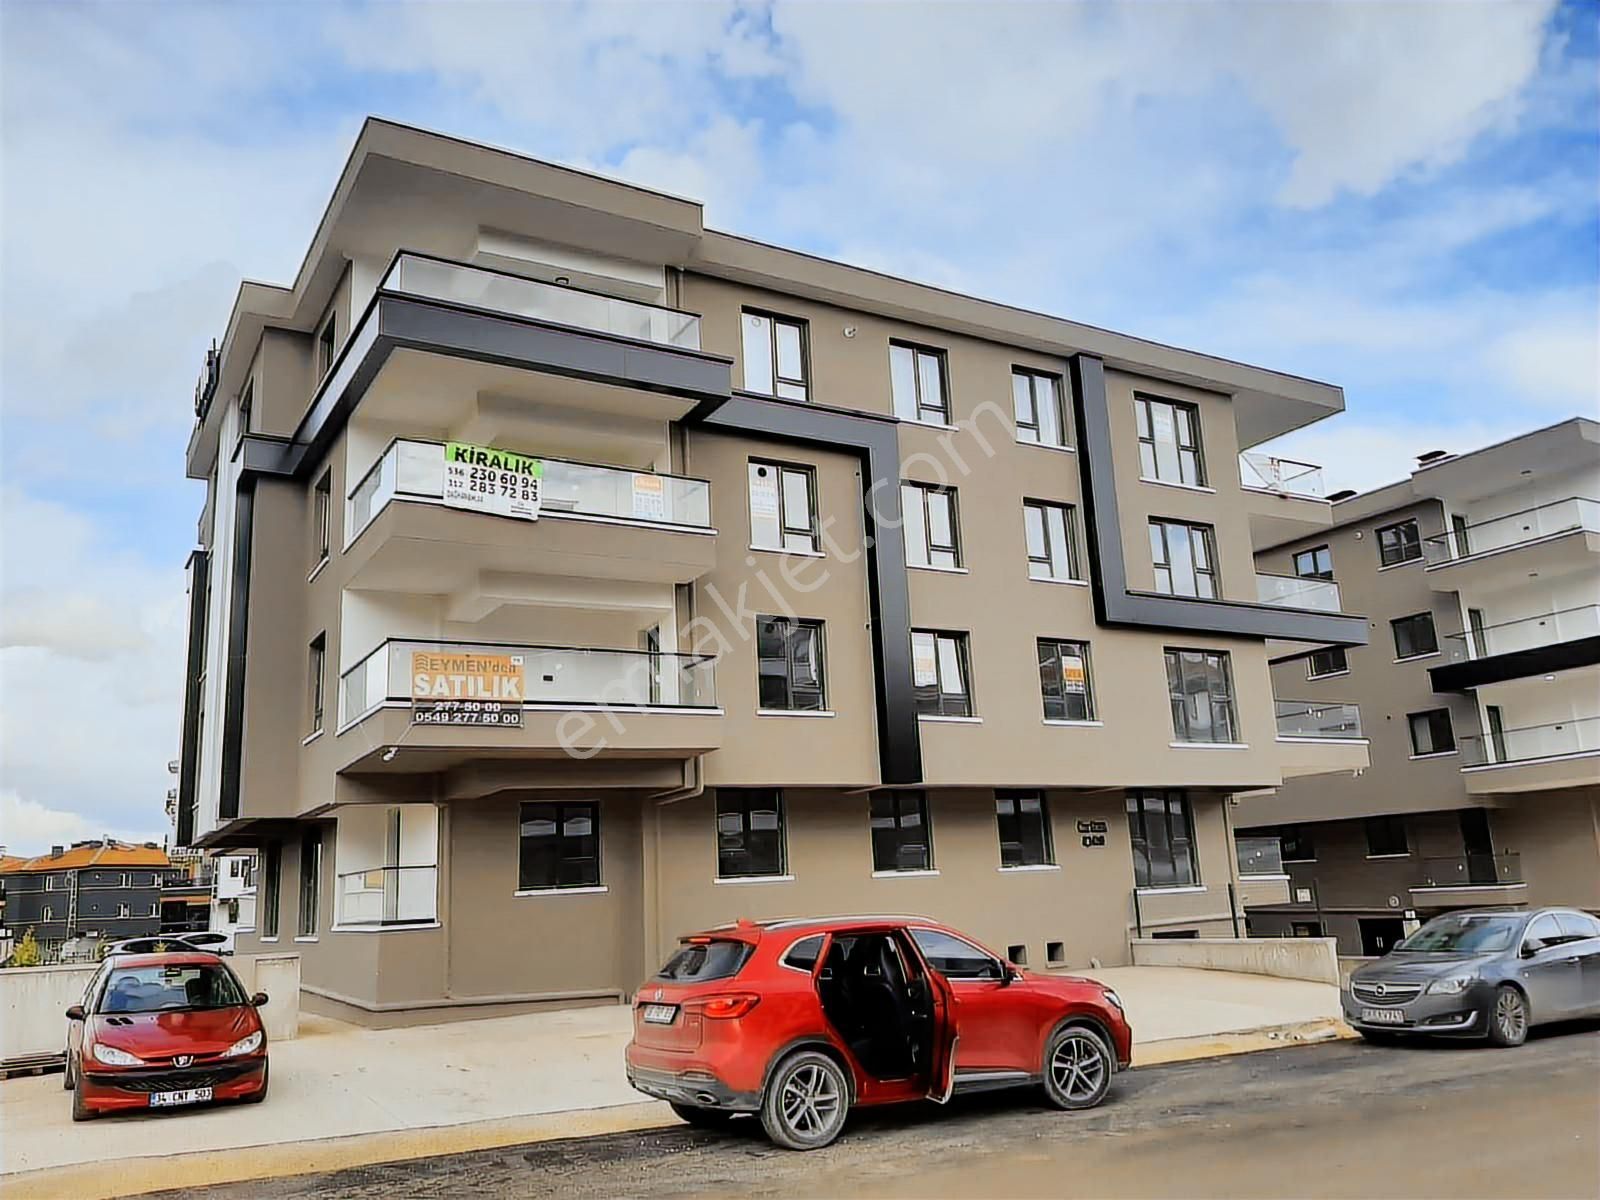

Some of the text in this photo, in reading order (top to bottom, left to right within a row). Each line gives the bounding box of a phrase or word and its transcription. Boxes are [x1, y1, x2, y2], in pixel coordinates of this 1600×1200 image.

[455, 447, 533, 475] KİRALIK
[469, 467, 496, 483] 230
[500, 472, 517, 486] 60
[521, 477, 538, 491] 94
[469, 480, 495, 495] 283
[500, 485, 517, 499] 72
[521, 490, 538, 502] 83
[414, 673, 521, 698] SATILIK
[415, 711, 519, 723] 0549 277 50 00
